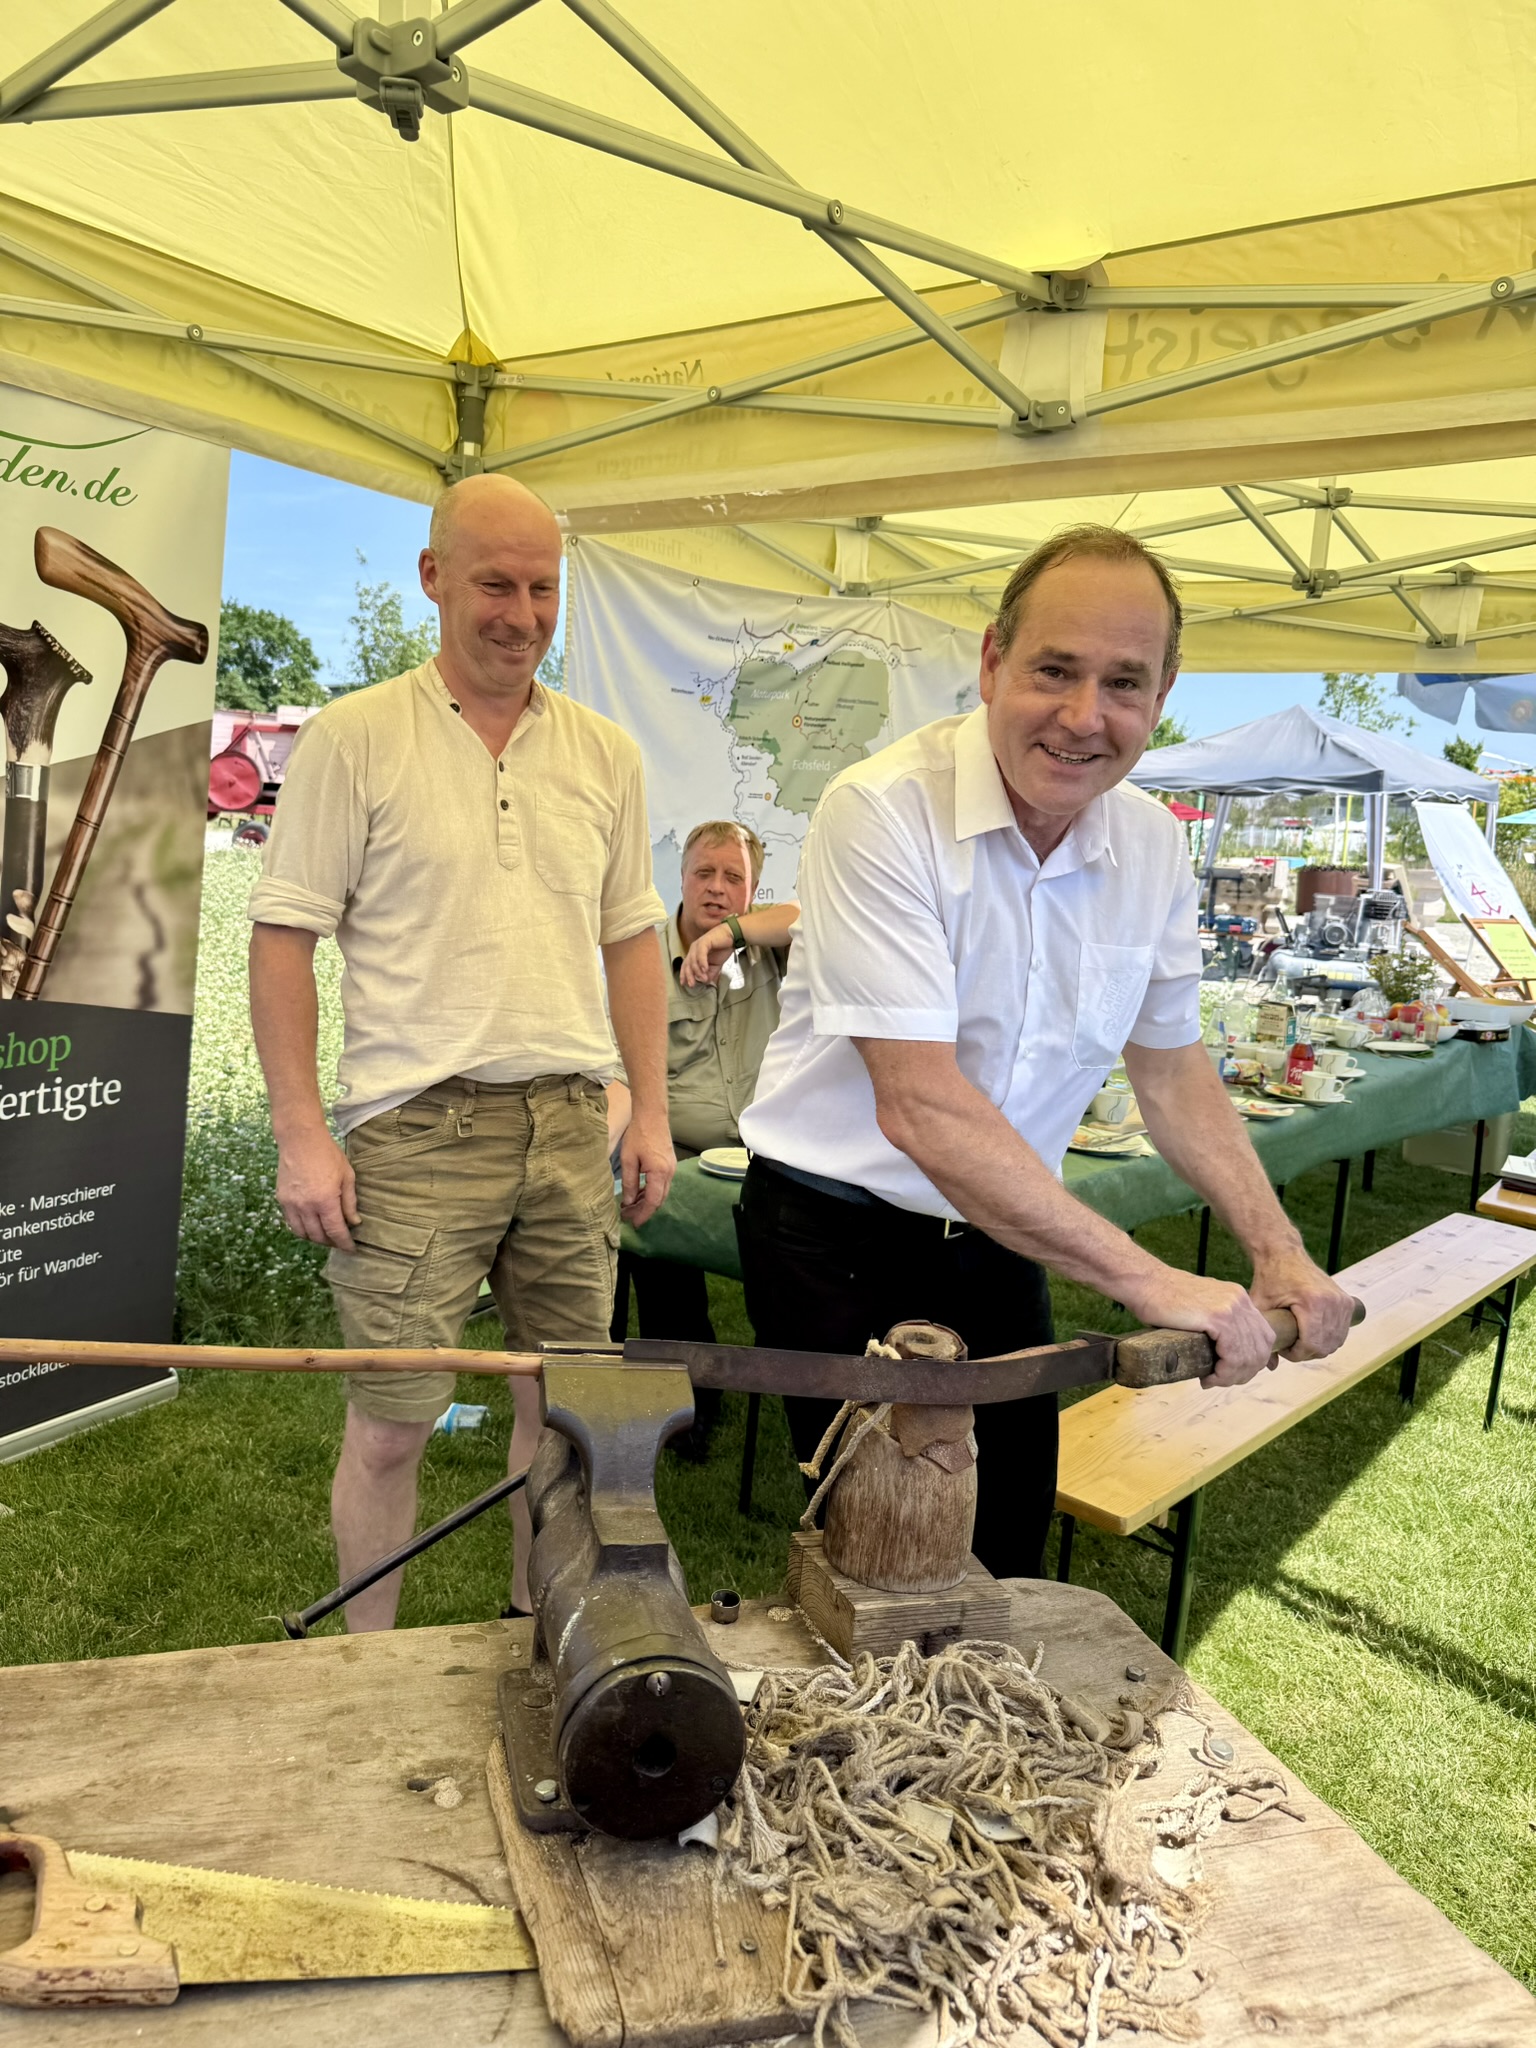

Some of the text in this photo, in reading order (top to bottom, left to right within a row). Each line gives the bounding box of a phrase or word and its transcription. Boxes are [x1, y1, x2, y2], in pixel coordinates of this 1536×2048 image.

[0, 1076, 122, 1121] ertigte
[30, 1183, 116, 1212] Marschierer
[18, 1266, 41, 1283] für
[44, 1251, 103, 1276] Wander-
